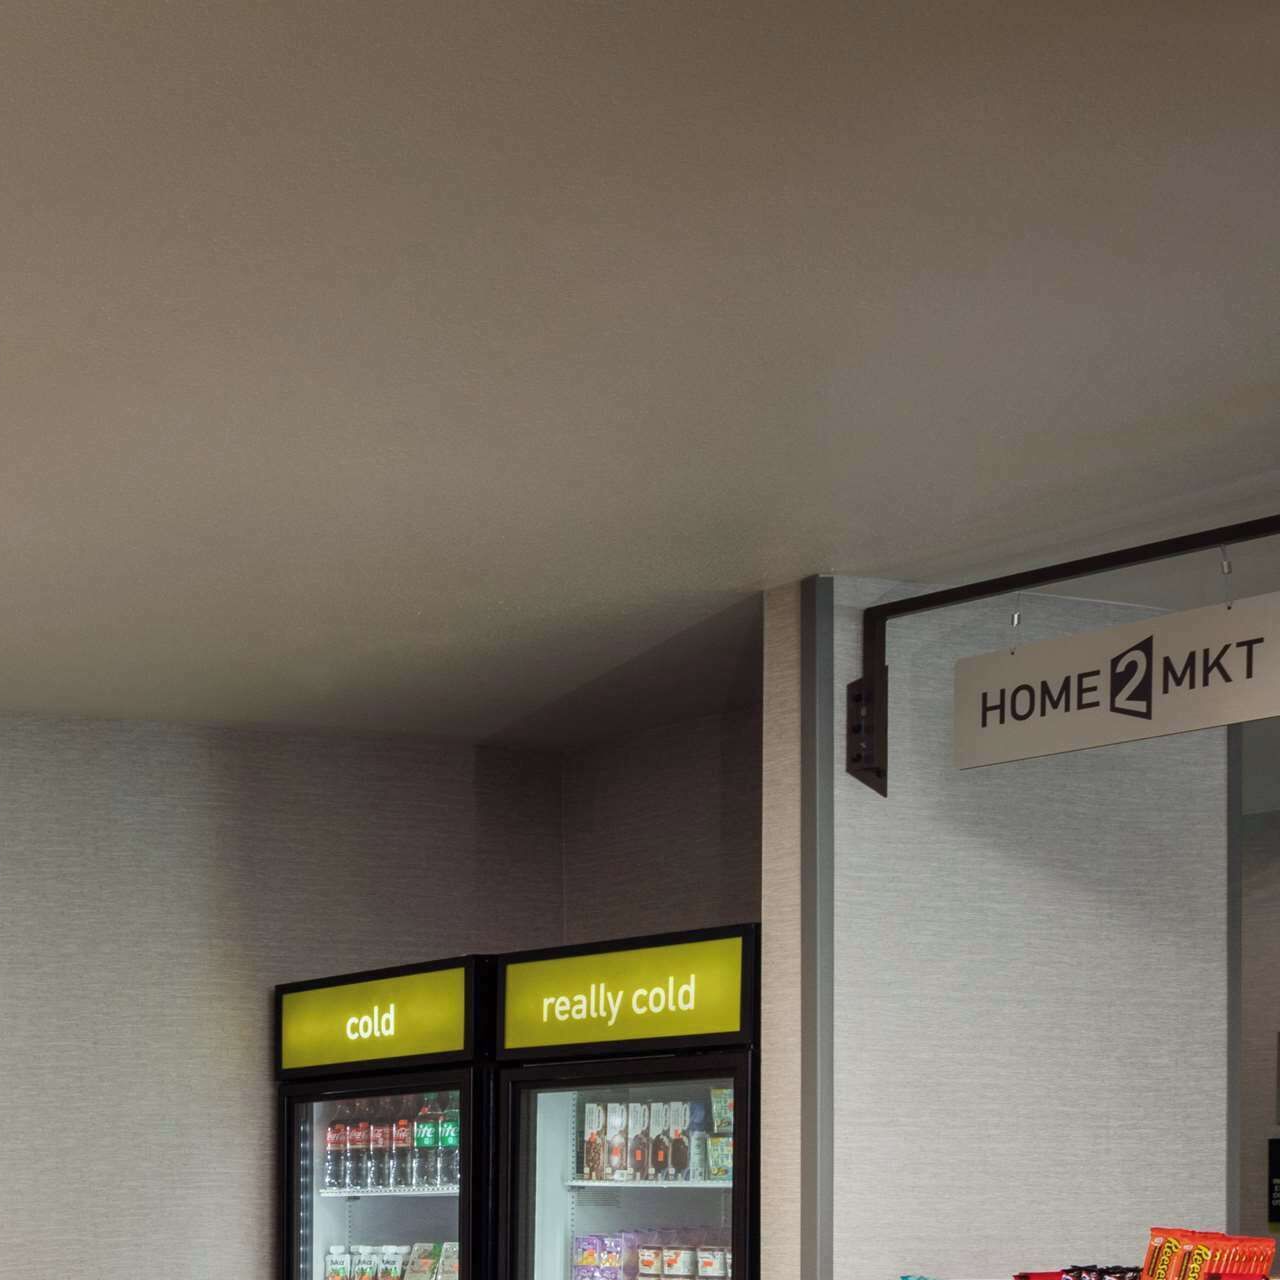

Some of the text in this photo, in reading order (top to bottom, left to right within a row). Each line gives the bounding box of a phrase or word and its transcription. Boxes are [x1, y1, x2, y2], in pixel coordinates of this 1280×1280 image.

[1162, 637, 1264, 694] MKT
[346, 1003, 395, 1040] cold
[542, 974, 696, 1027] really cold
